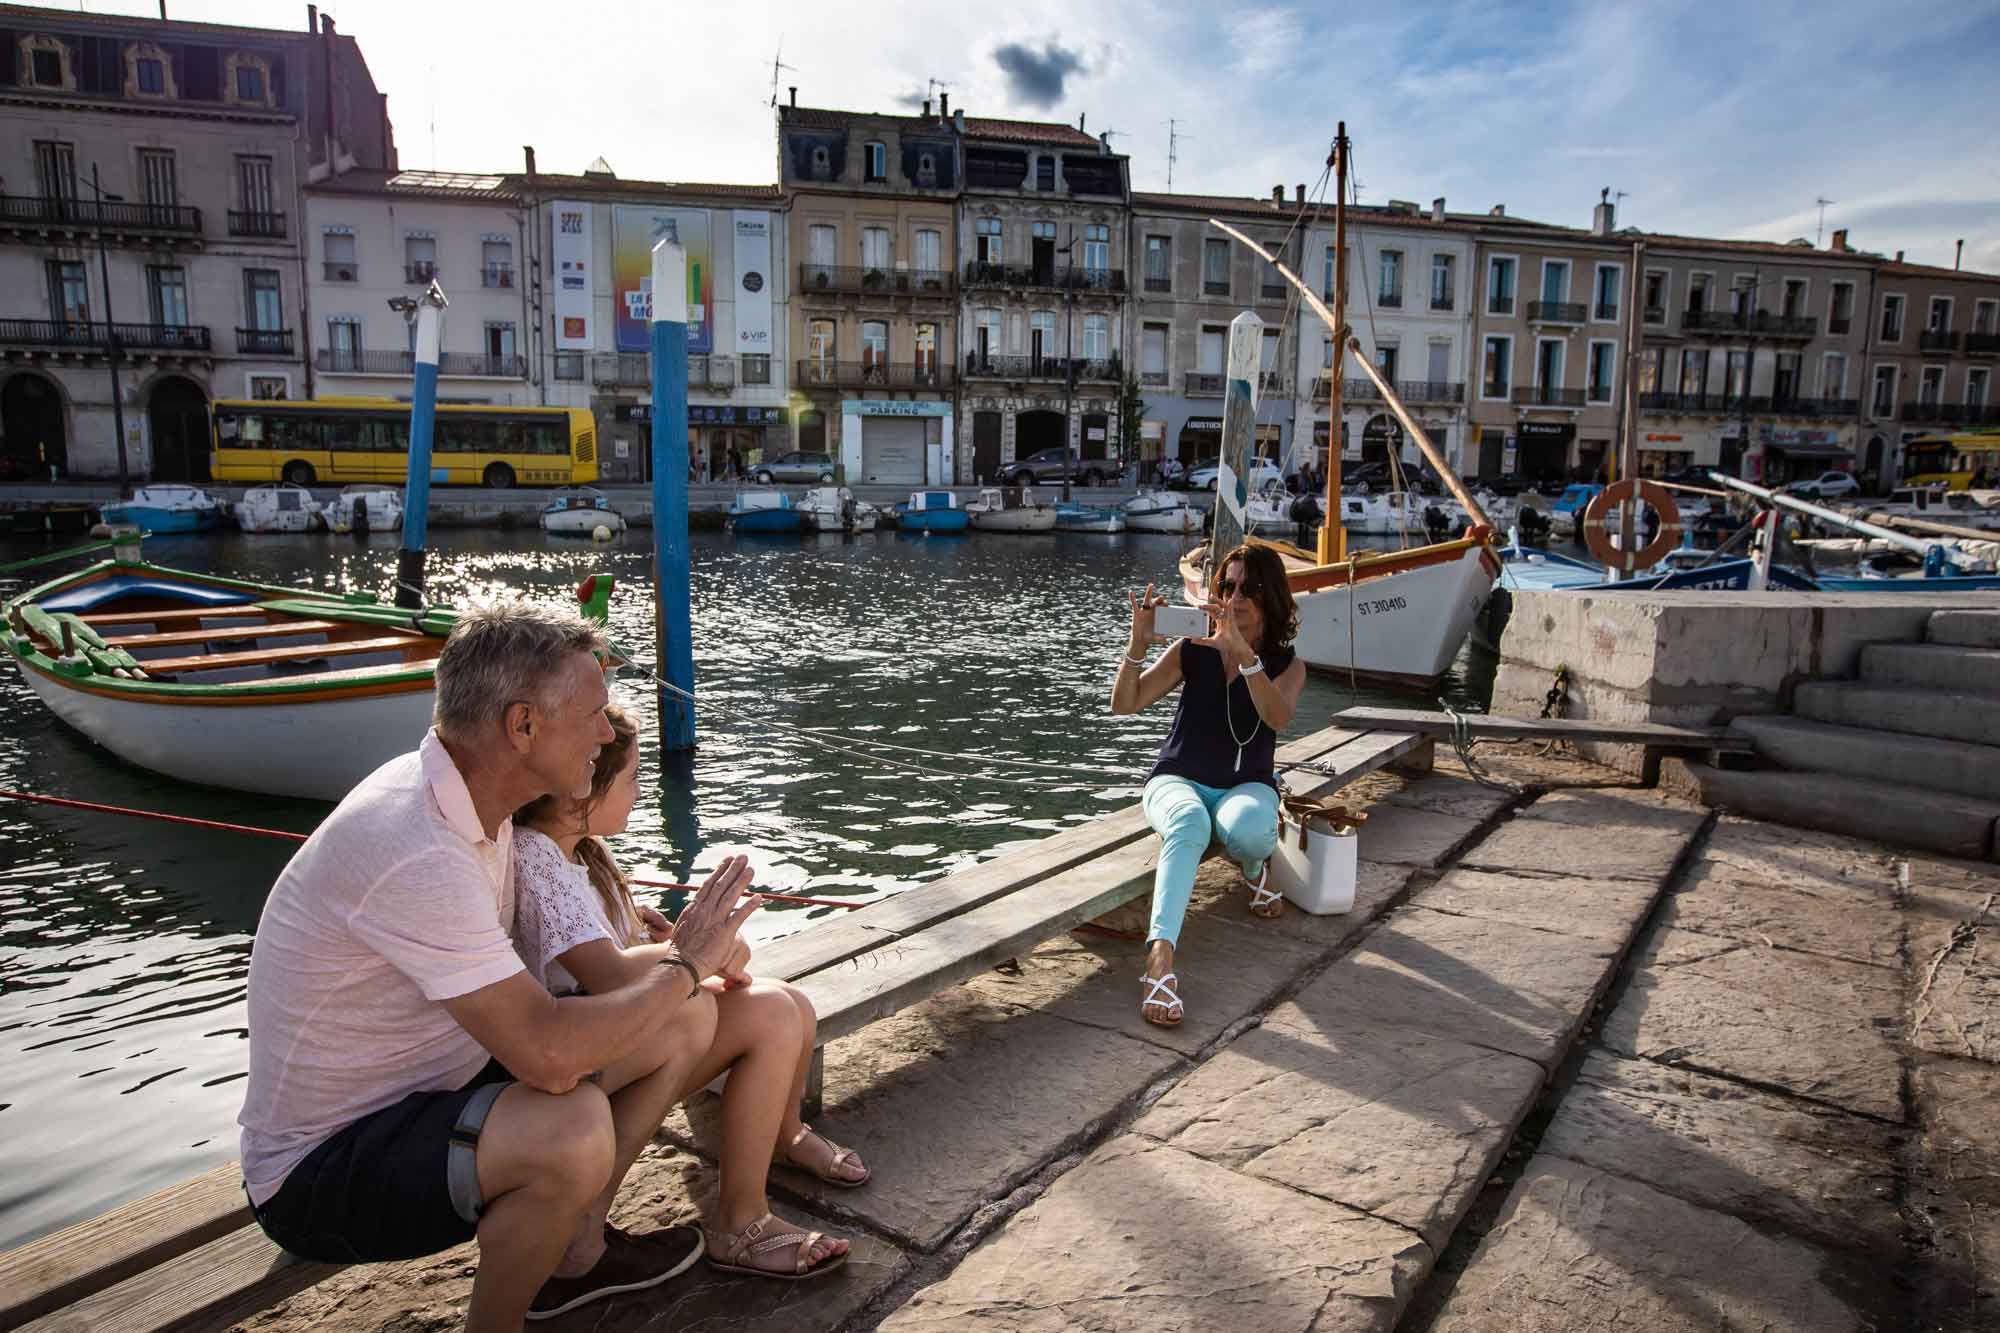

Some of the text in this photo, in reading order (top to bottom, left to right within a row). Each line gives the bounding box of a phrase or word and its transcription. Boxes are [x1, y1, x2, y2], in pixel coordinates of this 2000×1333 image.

[870, 407, 919, 415] PARKING
[1358, 596, 1408, 616] ST 310410
